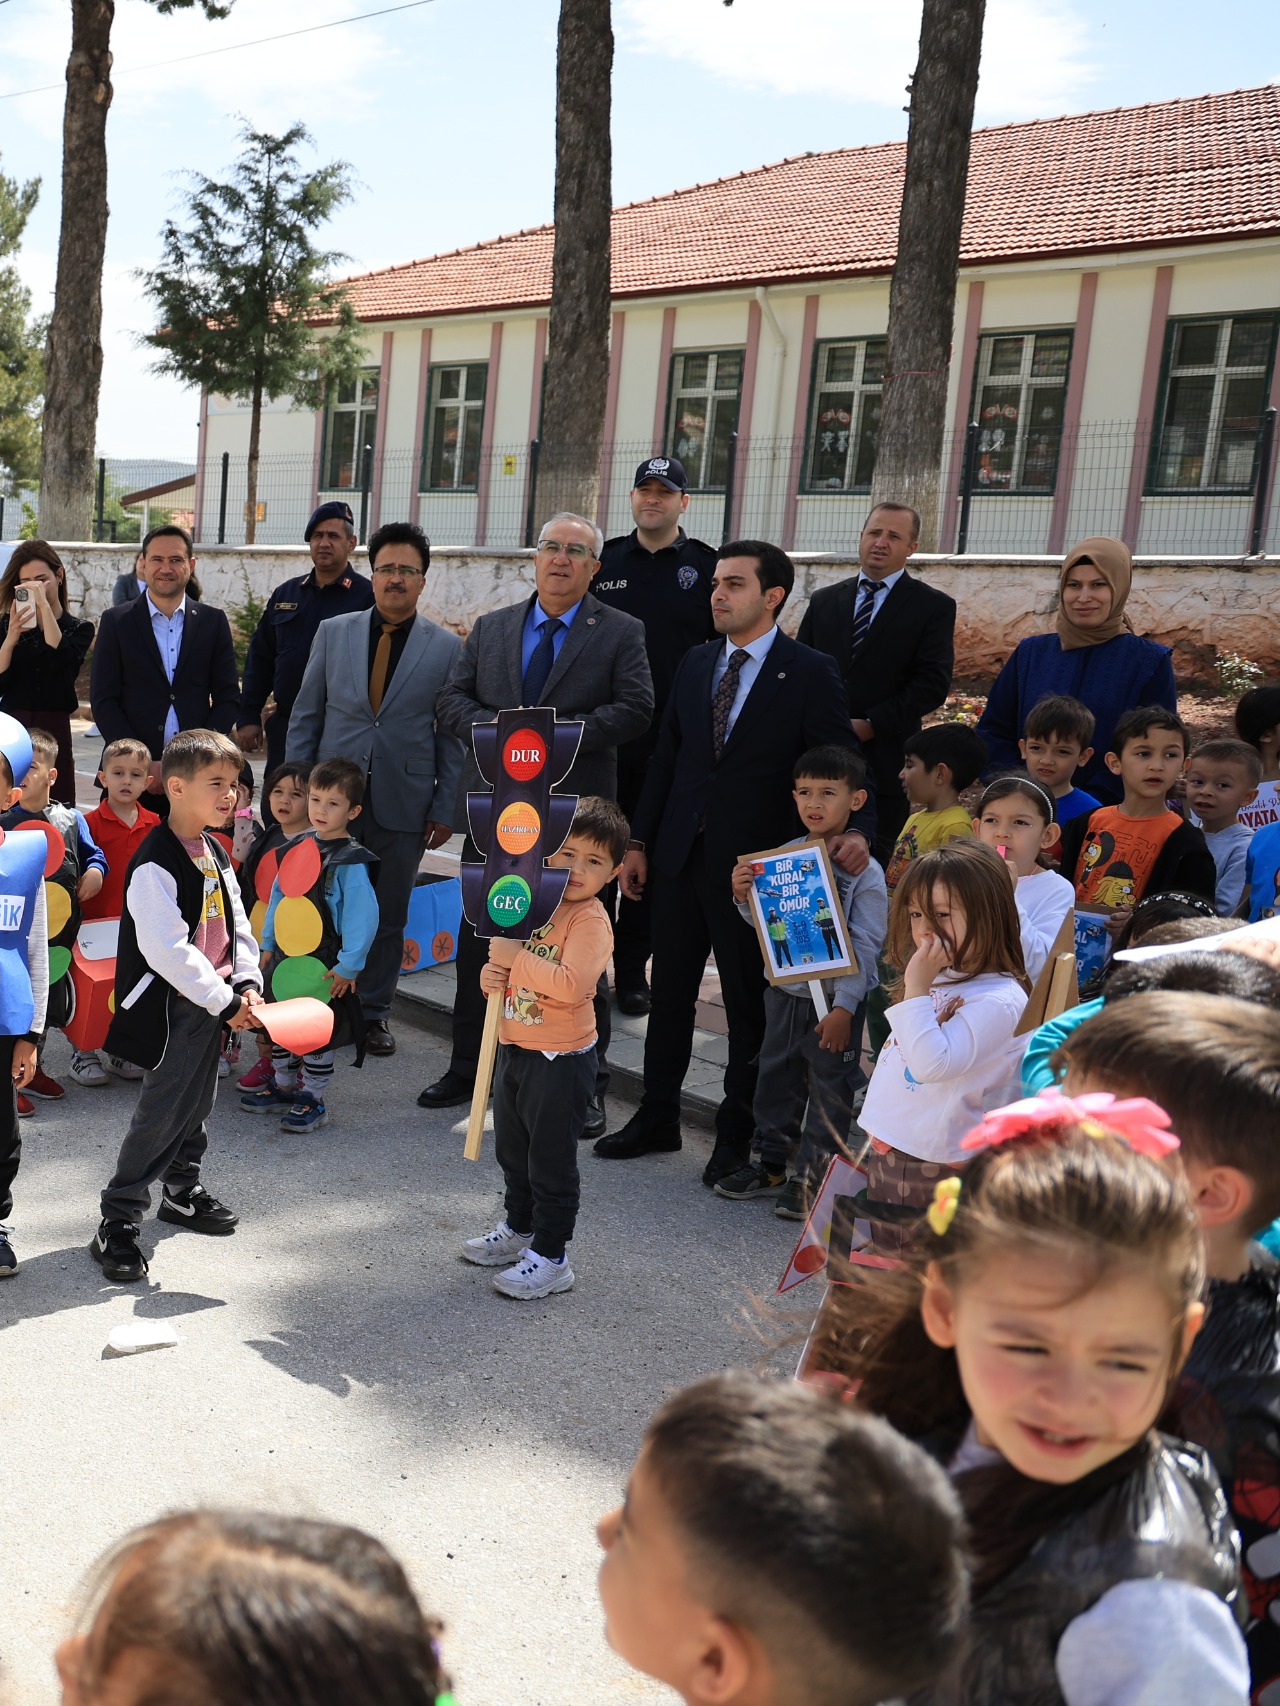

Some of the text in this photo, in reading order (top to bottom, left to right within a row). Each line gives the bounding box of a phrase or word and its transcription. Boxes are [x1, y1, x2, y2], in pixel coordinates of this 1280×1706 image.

[510, 749, 541, 763] DUR
[1238, 809, 1279, 828] AYATA
[500, 824, 539, 834] HAZIRLAN
[775, 860, 794, 873] BİR
[770, 870, 805, 887] KURAL
[782, 884, 800, 898] BİR
[493, 895, 526, 914] GEÇ
[779, 896, 811, 913] ÖMÜR
